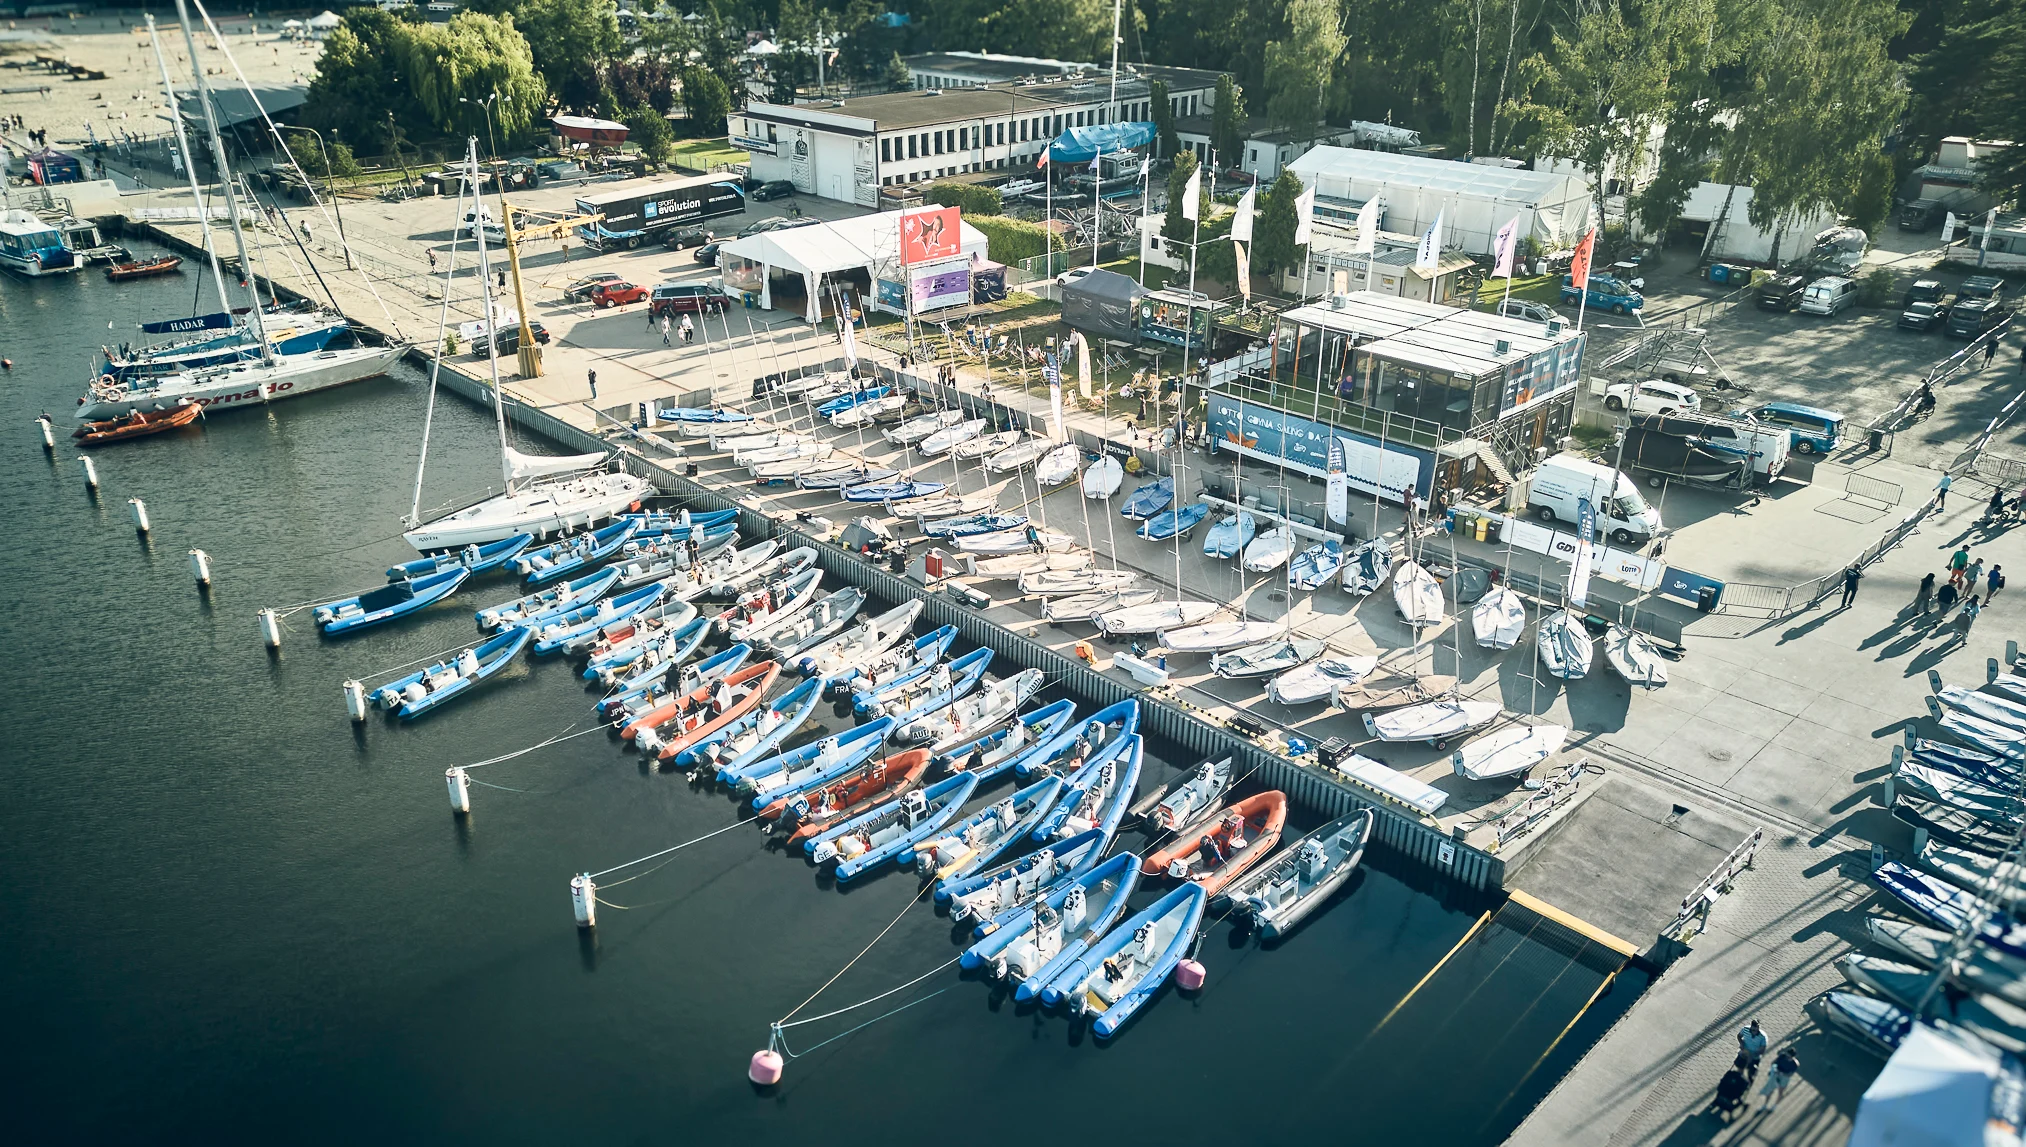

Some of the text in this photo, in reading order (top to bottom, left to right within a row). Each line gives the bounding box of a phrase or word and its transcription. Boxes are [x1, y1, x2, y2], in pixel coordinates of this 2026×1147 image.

[657, 198, 675, 208] SPORT
[658, 199, 701, 215] evolution
[170, 319, 206, 332] HADAR
[1217, 405, 1244, 420] LOTTO
[834, 684, 850, 694] FRA
[610, 706, 625, 717] JPN
[912, 729, 928, 740] AUT
